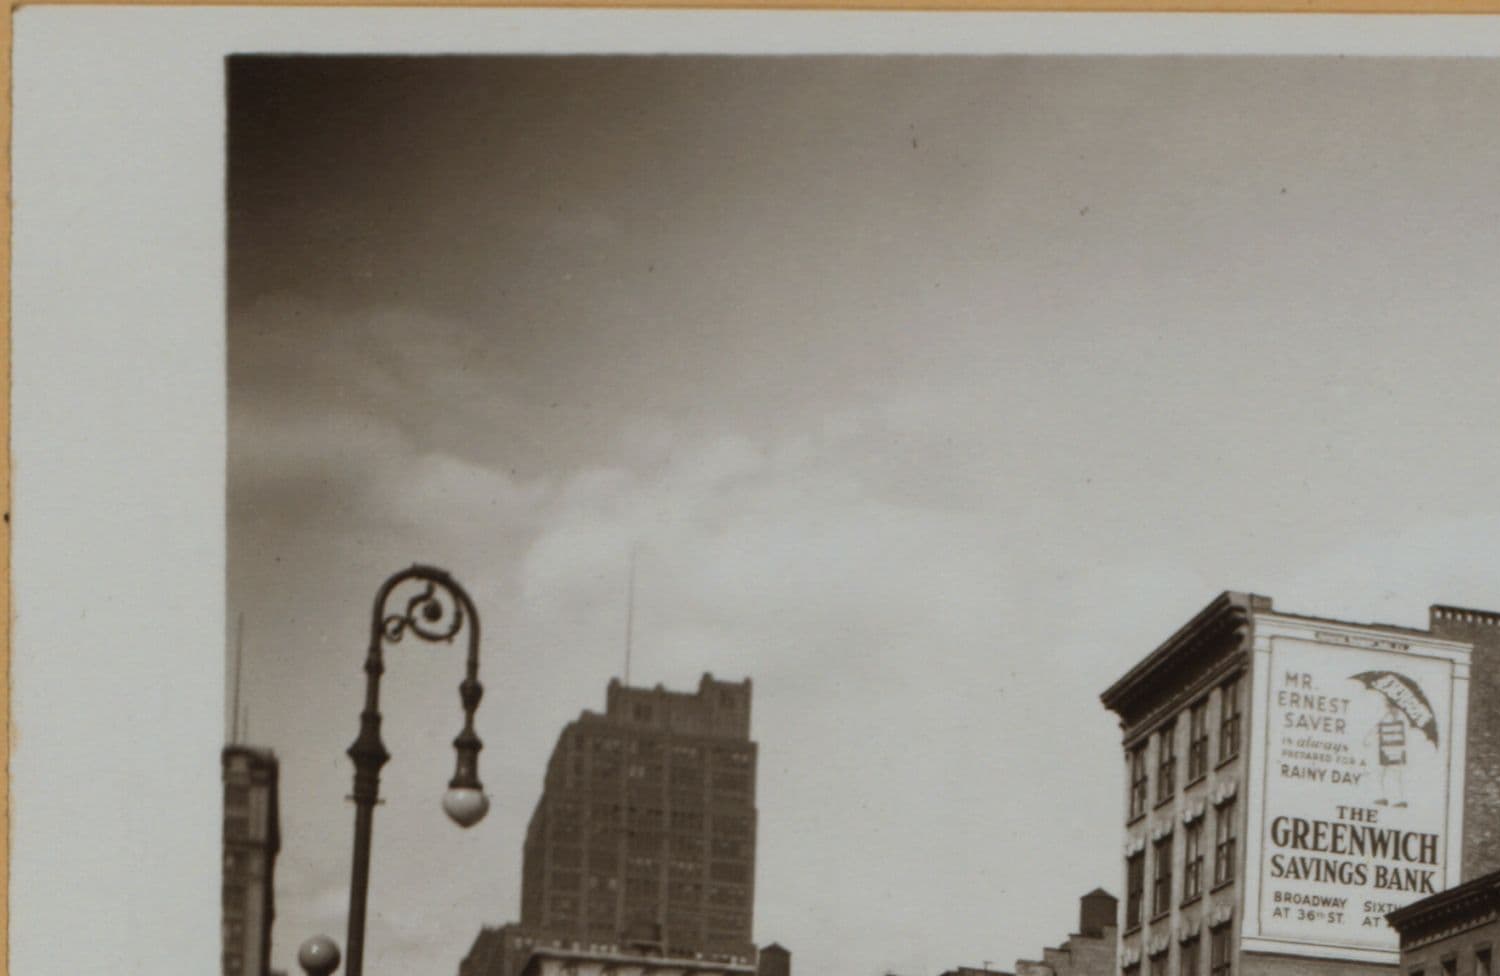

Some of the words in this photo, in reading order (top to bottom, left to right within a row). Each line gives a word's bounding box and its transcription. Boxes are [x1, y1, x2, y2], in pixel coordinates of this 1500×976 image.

[1285, 672, 1319, 691] MR.
[1278, 691, 1351, 714] ERNEST
[1284, 713, 1346, 735] SAVER
[1296, 737, 1350, 754] always
[1336, 805, 1379, 824] THE
[1271, 816, 1439, 865] GREENWICH
[1271, 854, 1367, 888] SAVINGS
[1375, 863, 1436, 894] BANK
[1273, 890, 1347, 909] BROADWAY
[1273, 906, 1291, 920] AT
[1362, 915, 1380, 928] AT
